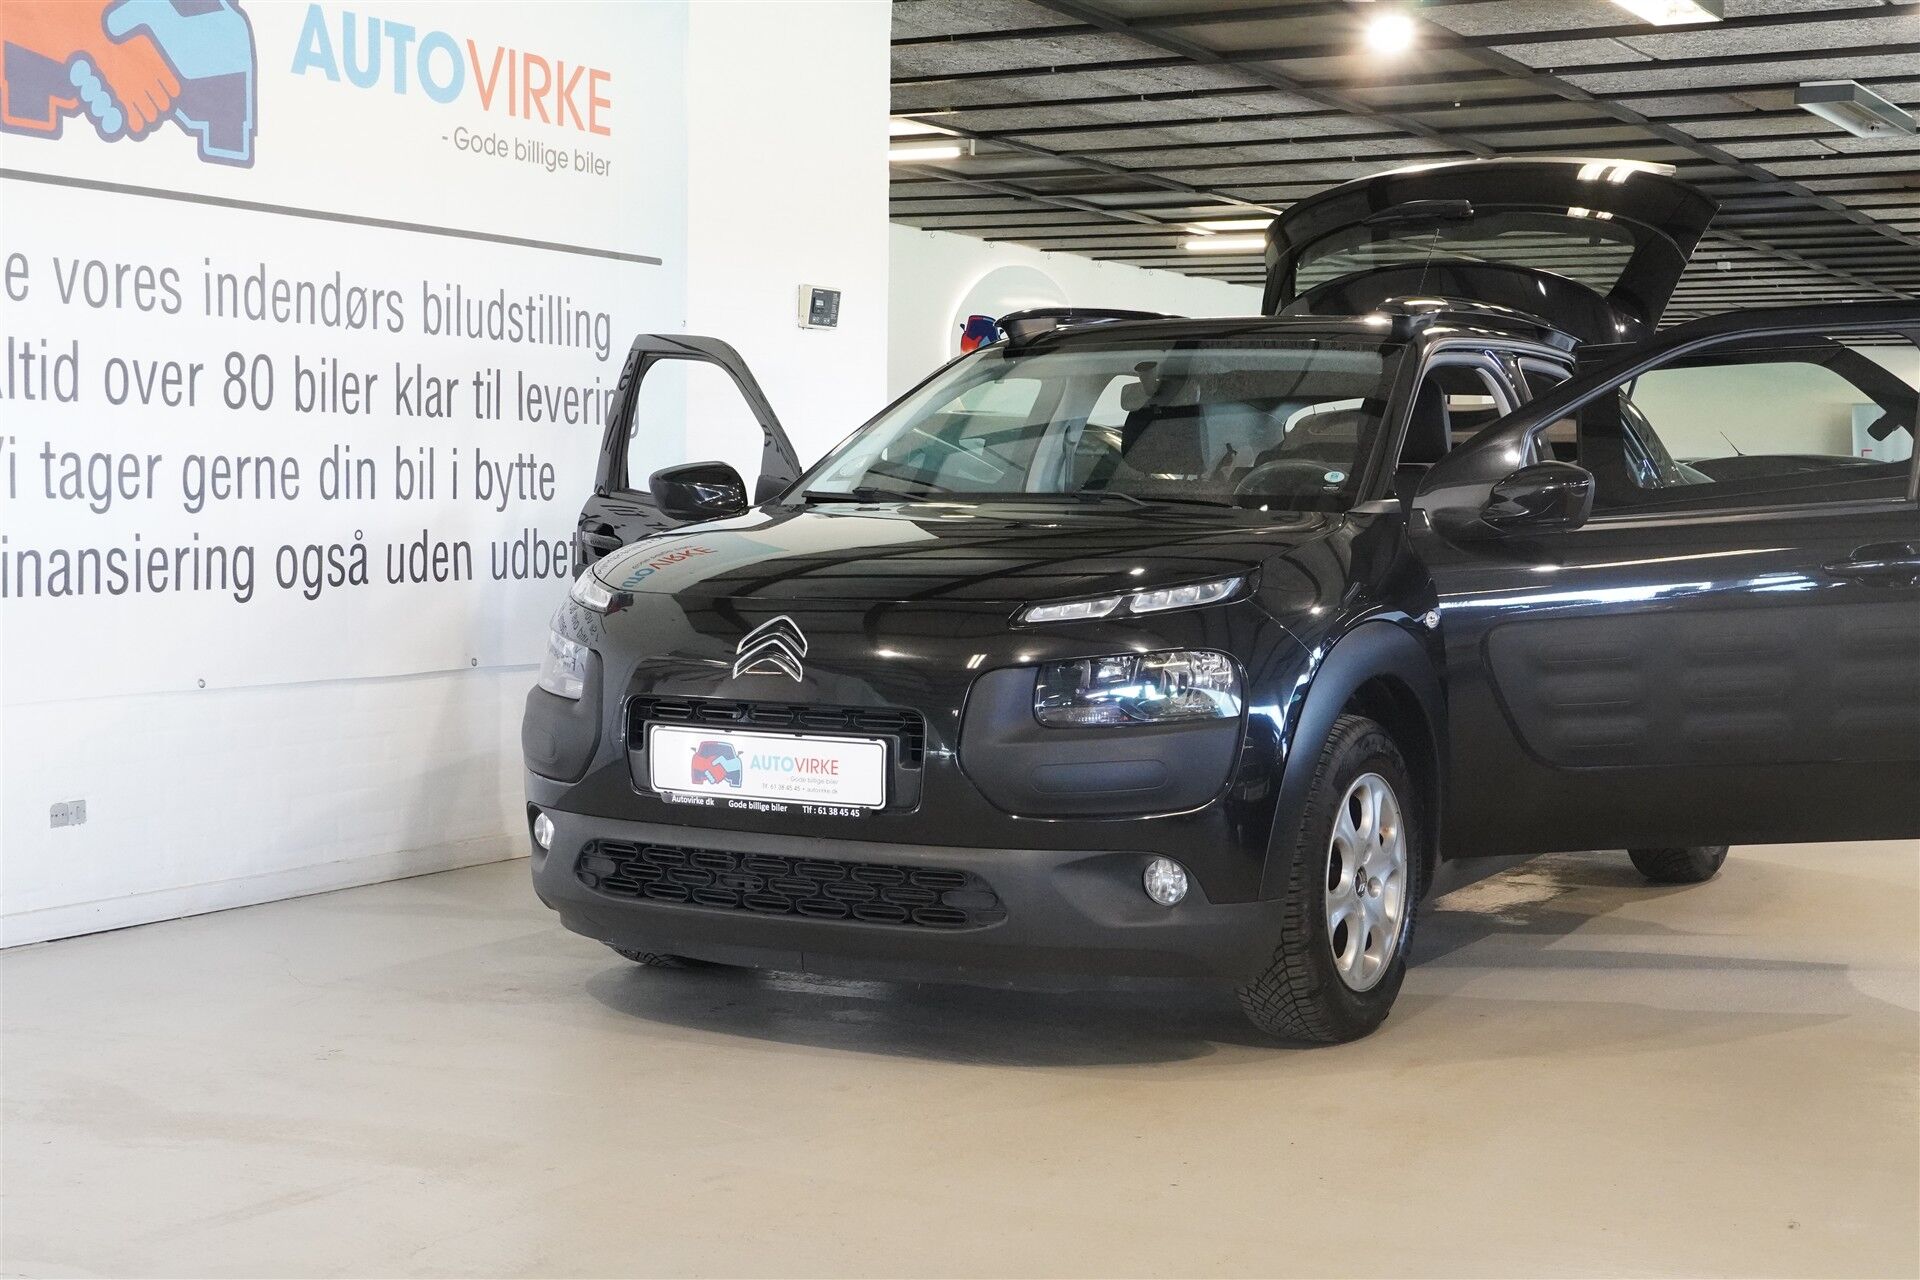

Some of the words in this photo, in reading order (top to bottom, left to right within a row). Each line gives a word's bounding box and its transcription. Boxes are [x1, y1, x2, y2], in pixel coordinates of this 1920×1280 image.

[290, 3, 612, 137] AUTOVIRKE
[453, 126, 509, 162] Gode
[514, 136, 569, 173] billige
[574, 148, 612, 177] biler
[4, 251, 30, 302] e
[52, 256, 183, 315] vores
[204, 256, 405, 334] indendørs
[422, 279, 611, 363] biludstilling
[0, 335, 79, 403] ltid
[104, 357, 205, 408] over
[222, 350, 274, 412] 80
[294, 354, 379, 414] biler
[395, 361, 460, 419] klar
[471, 367, 501, 421] til
[39, 440, 163, 515] tager
[182, 454, 300, 515] gerne
[319, 443, 376, 501] din
[395, 445, 435, 501] bil
[452, 447, 458, 500] i
[475, 447, 556, 513] bytte
[0, 531, 255, 604] inansiering
[275, 528, 370, 602] også
[386, 528, 473, 585] uden
[491, 527, 577, 581] udbet
[750, 754, 839, 776] AUTOVIRKE
[728, 799, 747, 809] Gode
[748, 801, 770, 812] billige
[771, 802, 788, 812] biler
[802, 805, 813, 814] Tlf
[817, 807, 828, 815] 61
[828, 807, 838, 816] 38
[839, 808, 849, 817] 45
[850, 809, 860, 817] 45
